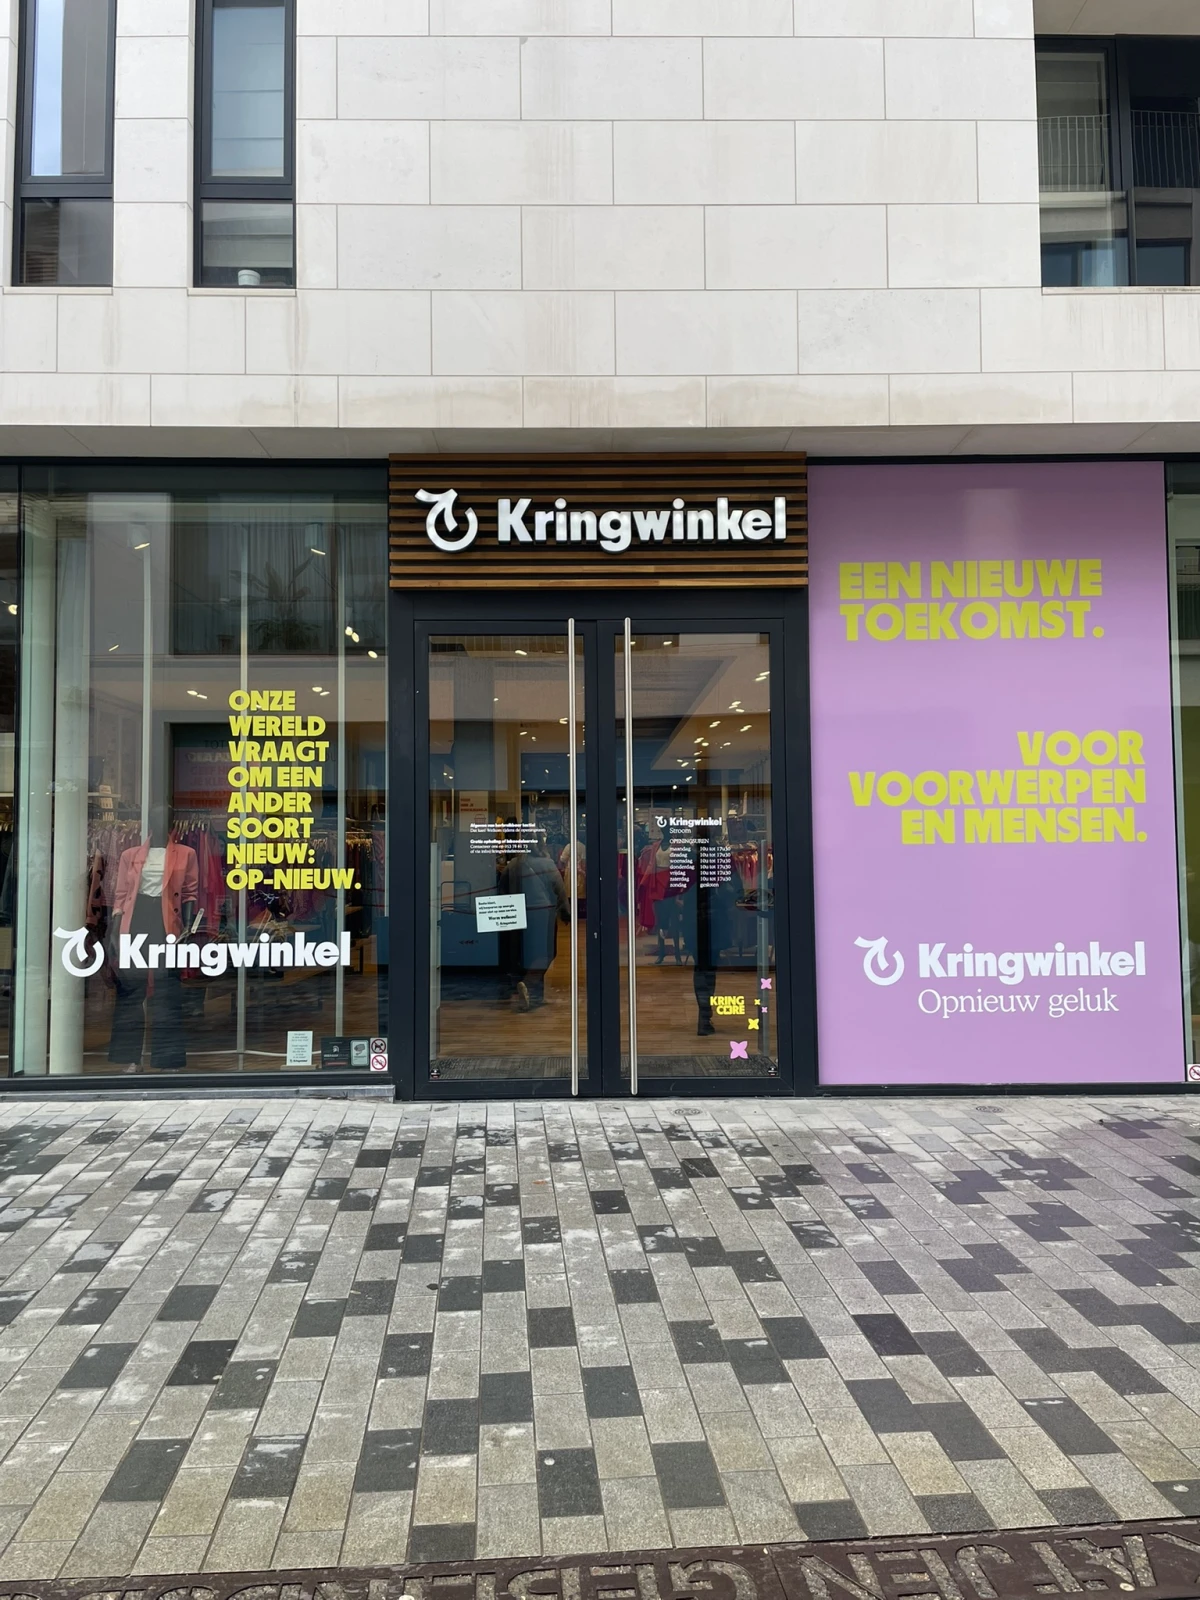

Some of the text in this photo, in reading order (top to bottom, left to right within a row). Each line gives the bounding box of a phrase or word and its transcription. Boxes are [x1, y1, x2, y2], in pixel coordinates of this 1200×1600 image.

[498, 497, 788, 553] Kringwinkel
[839, 559, 1102, 600] EEN NIEUWE
[839, 600, 1105, 641] TOEKOMST.
[228, 689, 296, 712] ONZE
[228, 715, 326, 737] WERELD
[228, 740, 330, 762] VRAAGT
[1017, 730, 1144, 767] VOOR
[227, 766, 273, 788] OM
[276, 766, 323, 788] EEN
[848, 769, 1146, 807] VOORWERPEN
[227, 791, 312, 814] ANDER
[226, 816, 314, 839] SOORT
[669, 817, 722, 828] Kringwinkel
[901, 807, 1148, 846] EN MENSEN.
[226, 843, 315, 865] NIEUW:
[119, 931, 351, 977] Kringwinkel
[918, 940, 1146, 986] Kringwinkel
[709, 995, 745, 1006] KRING
[917, 987, 1120, 1020] Opnieuw geluk
